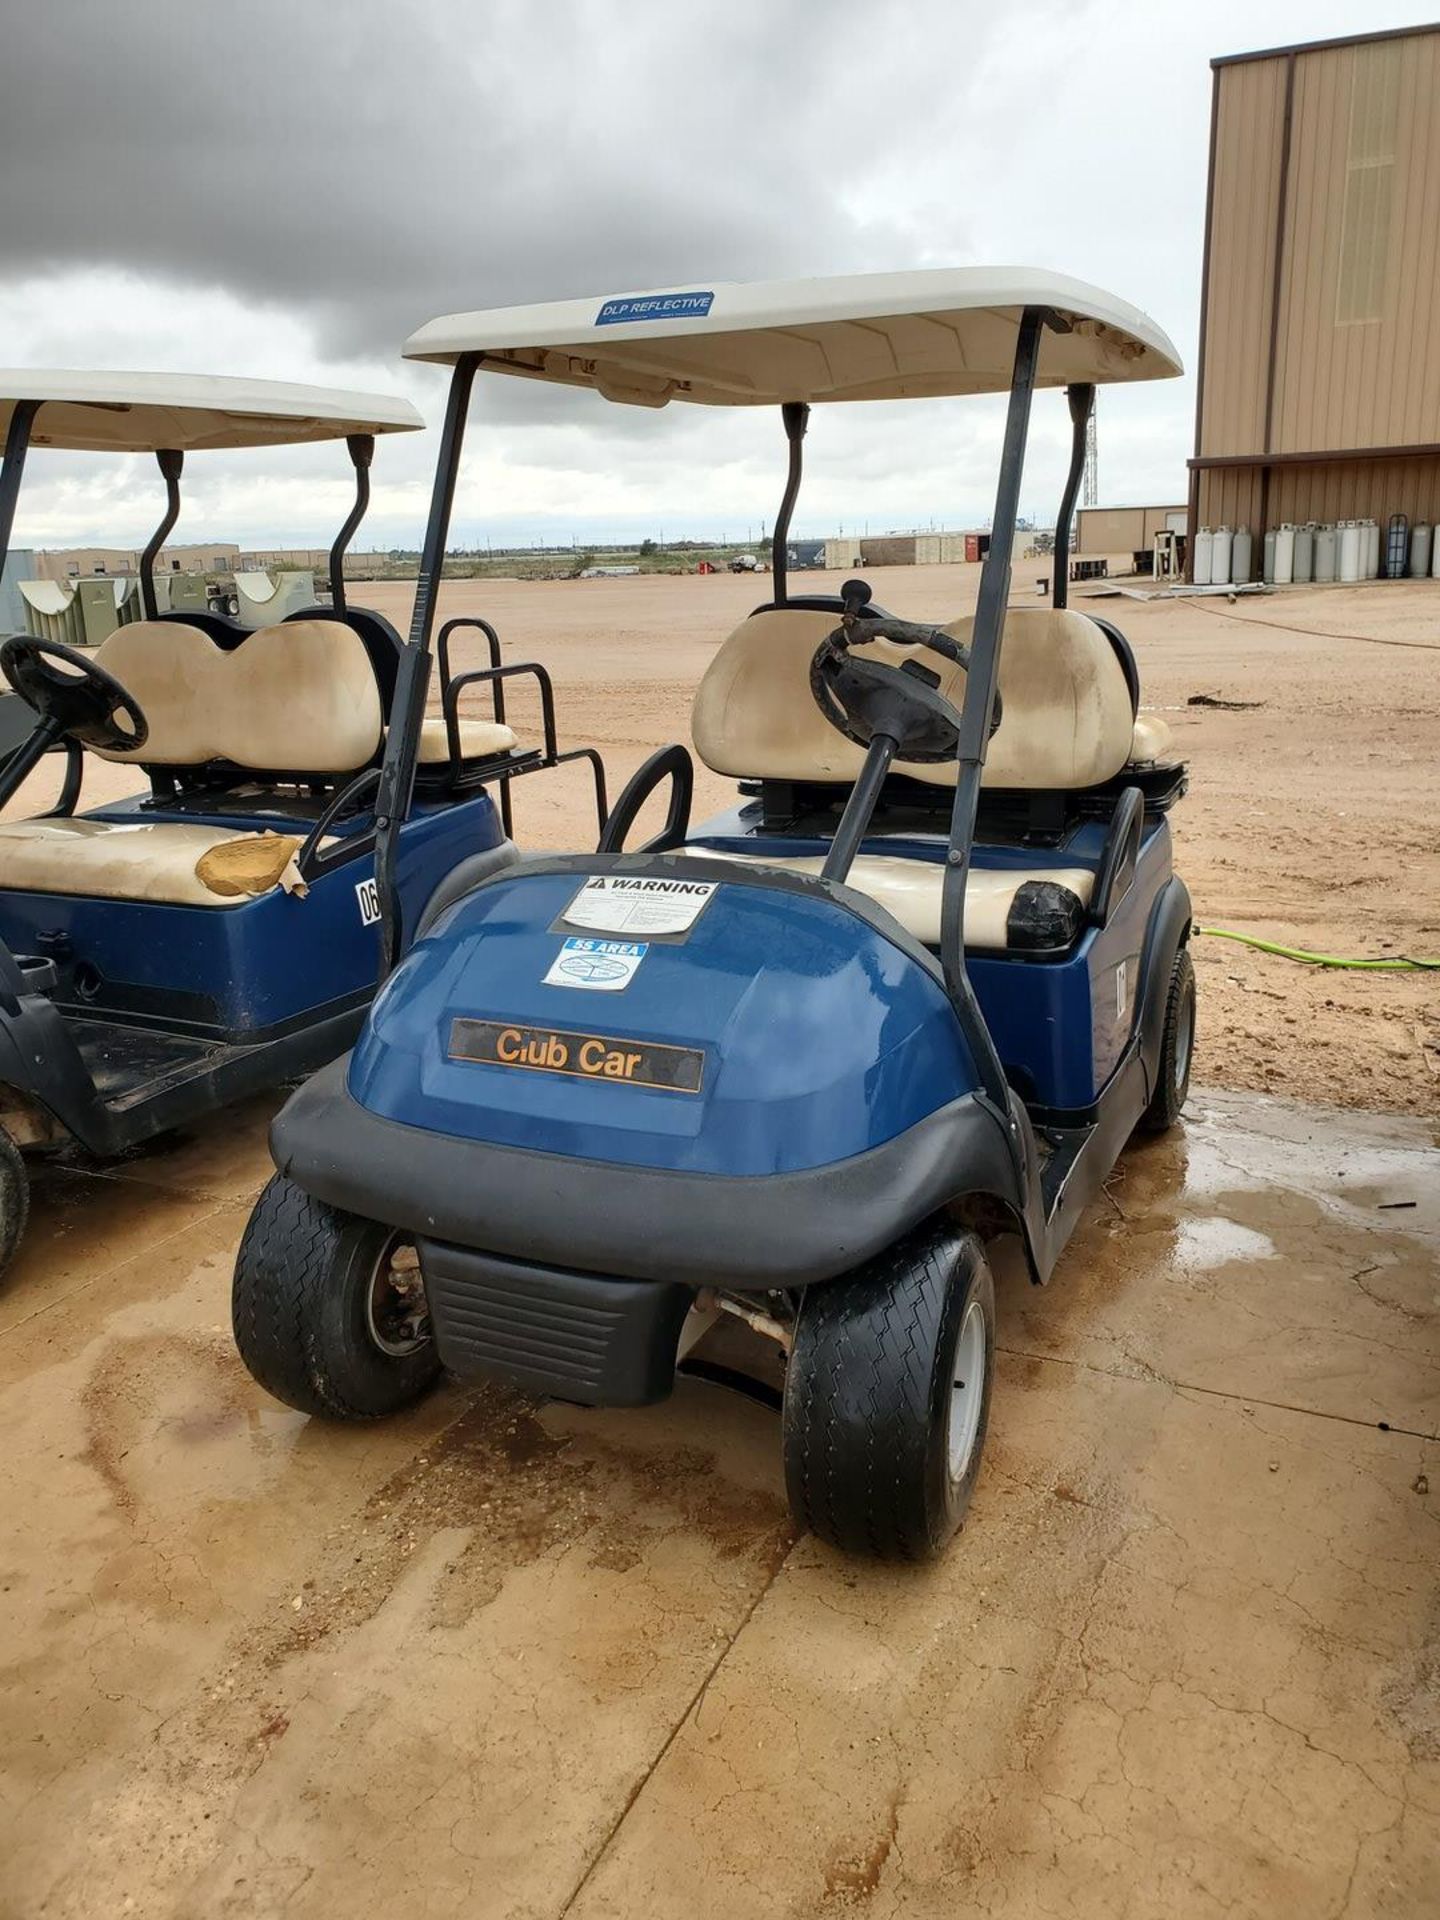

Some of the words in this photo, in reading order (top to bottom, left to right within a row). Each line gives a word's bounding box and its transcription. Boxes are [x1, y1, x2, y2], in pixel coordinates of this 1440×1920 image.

[602, 304, 629, 316] DLP
[630, 297, 711, 313] REFLECTIVE
[611, 879, 711, 895] WARNING
[573, 939, 594, 950] 5S
[595, 943, 639, 955] AREA
[579, 1040, 641, 1077] Car
